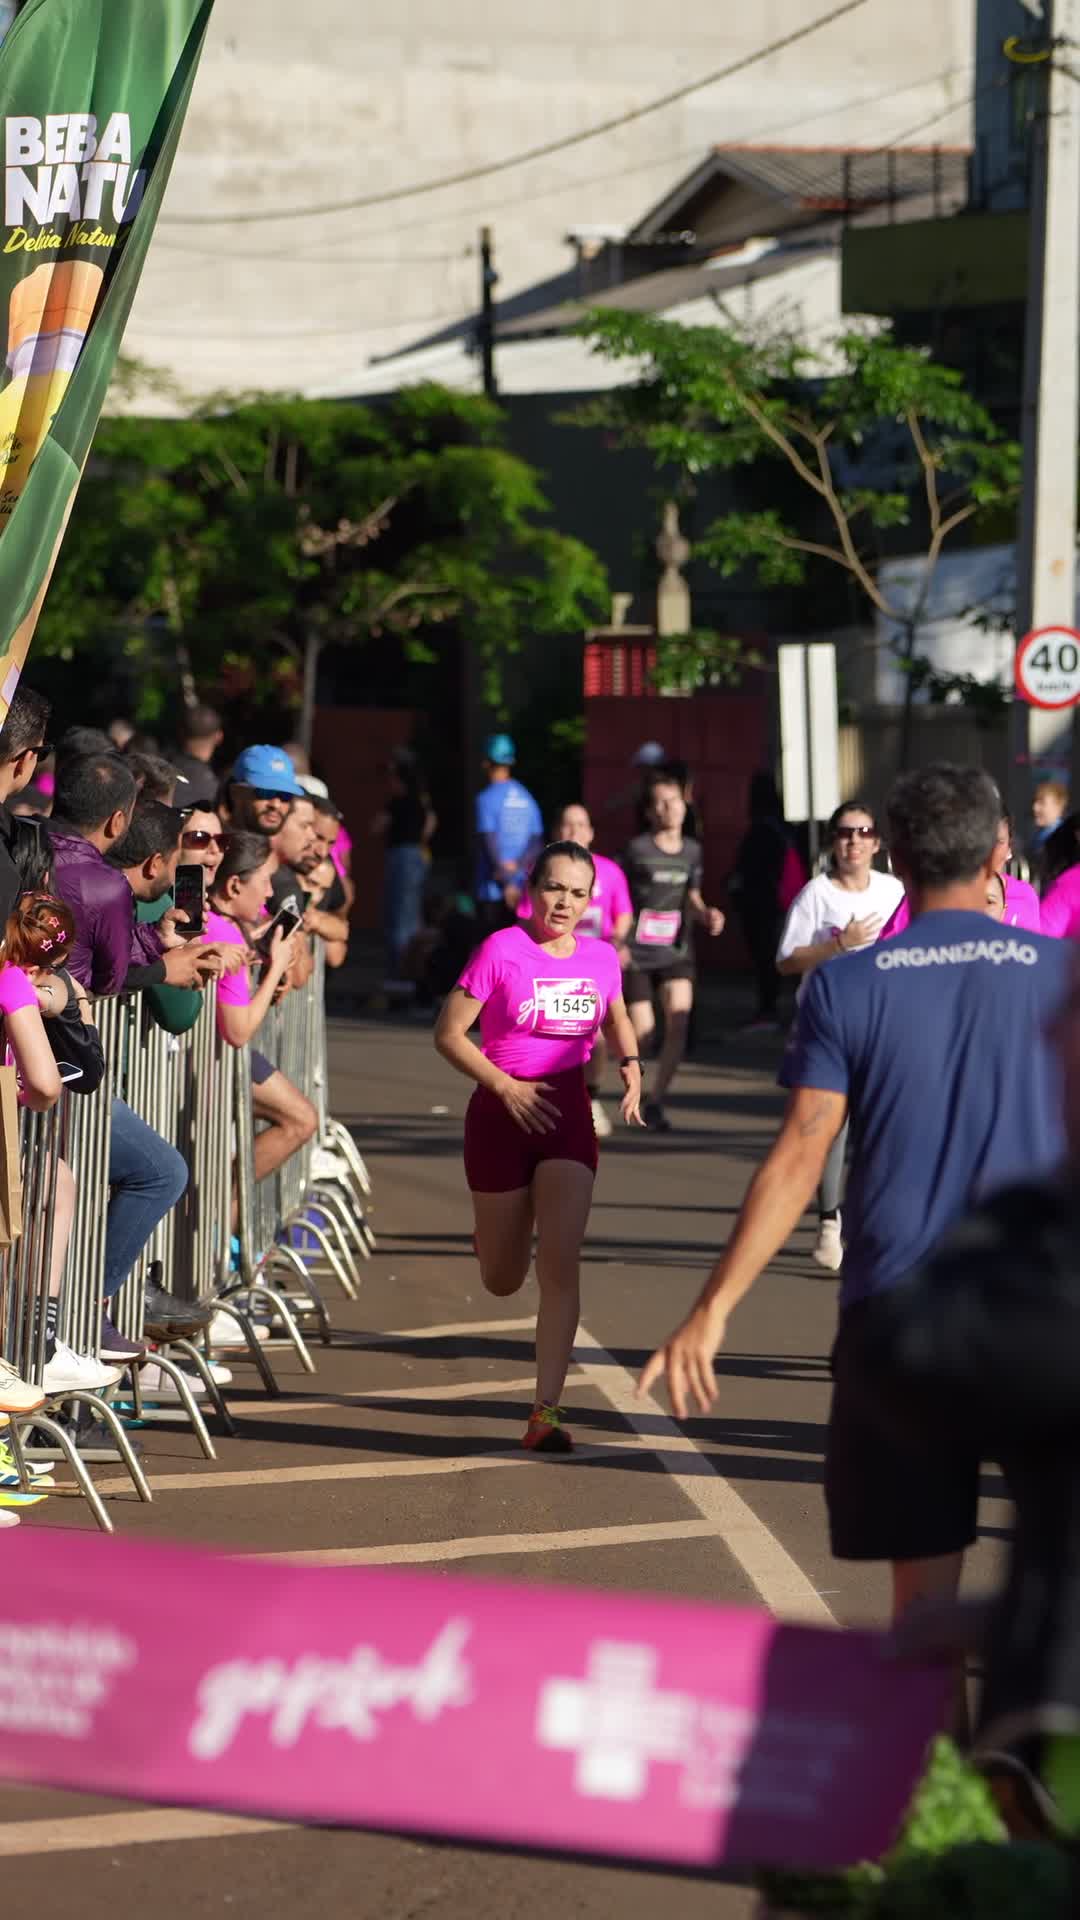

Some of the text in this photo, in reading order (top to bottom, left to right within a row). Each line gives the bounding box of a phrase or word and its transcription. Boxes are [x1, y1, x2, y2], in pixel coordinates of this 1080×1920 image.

[5, 112, 131, 166] BEBA
[5, 161, 147, 226] NATU
[1030, 643, 1078, 673] 40
[875, 939, 1039, 970] ORGANIZAÇÃO
[552, 998, 590, 1014] 1545
